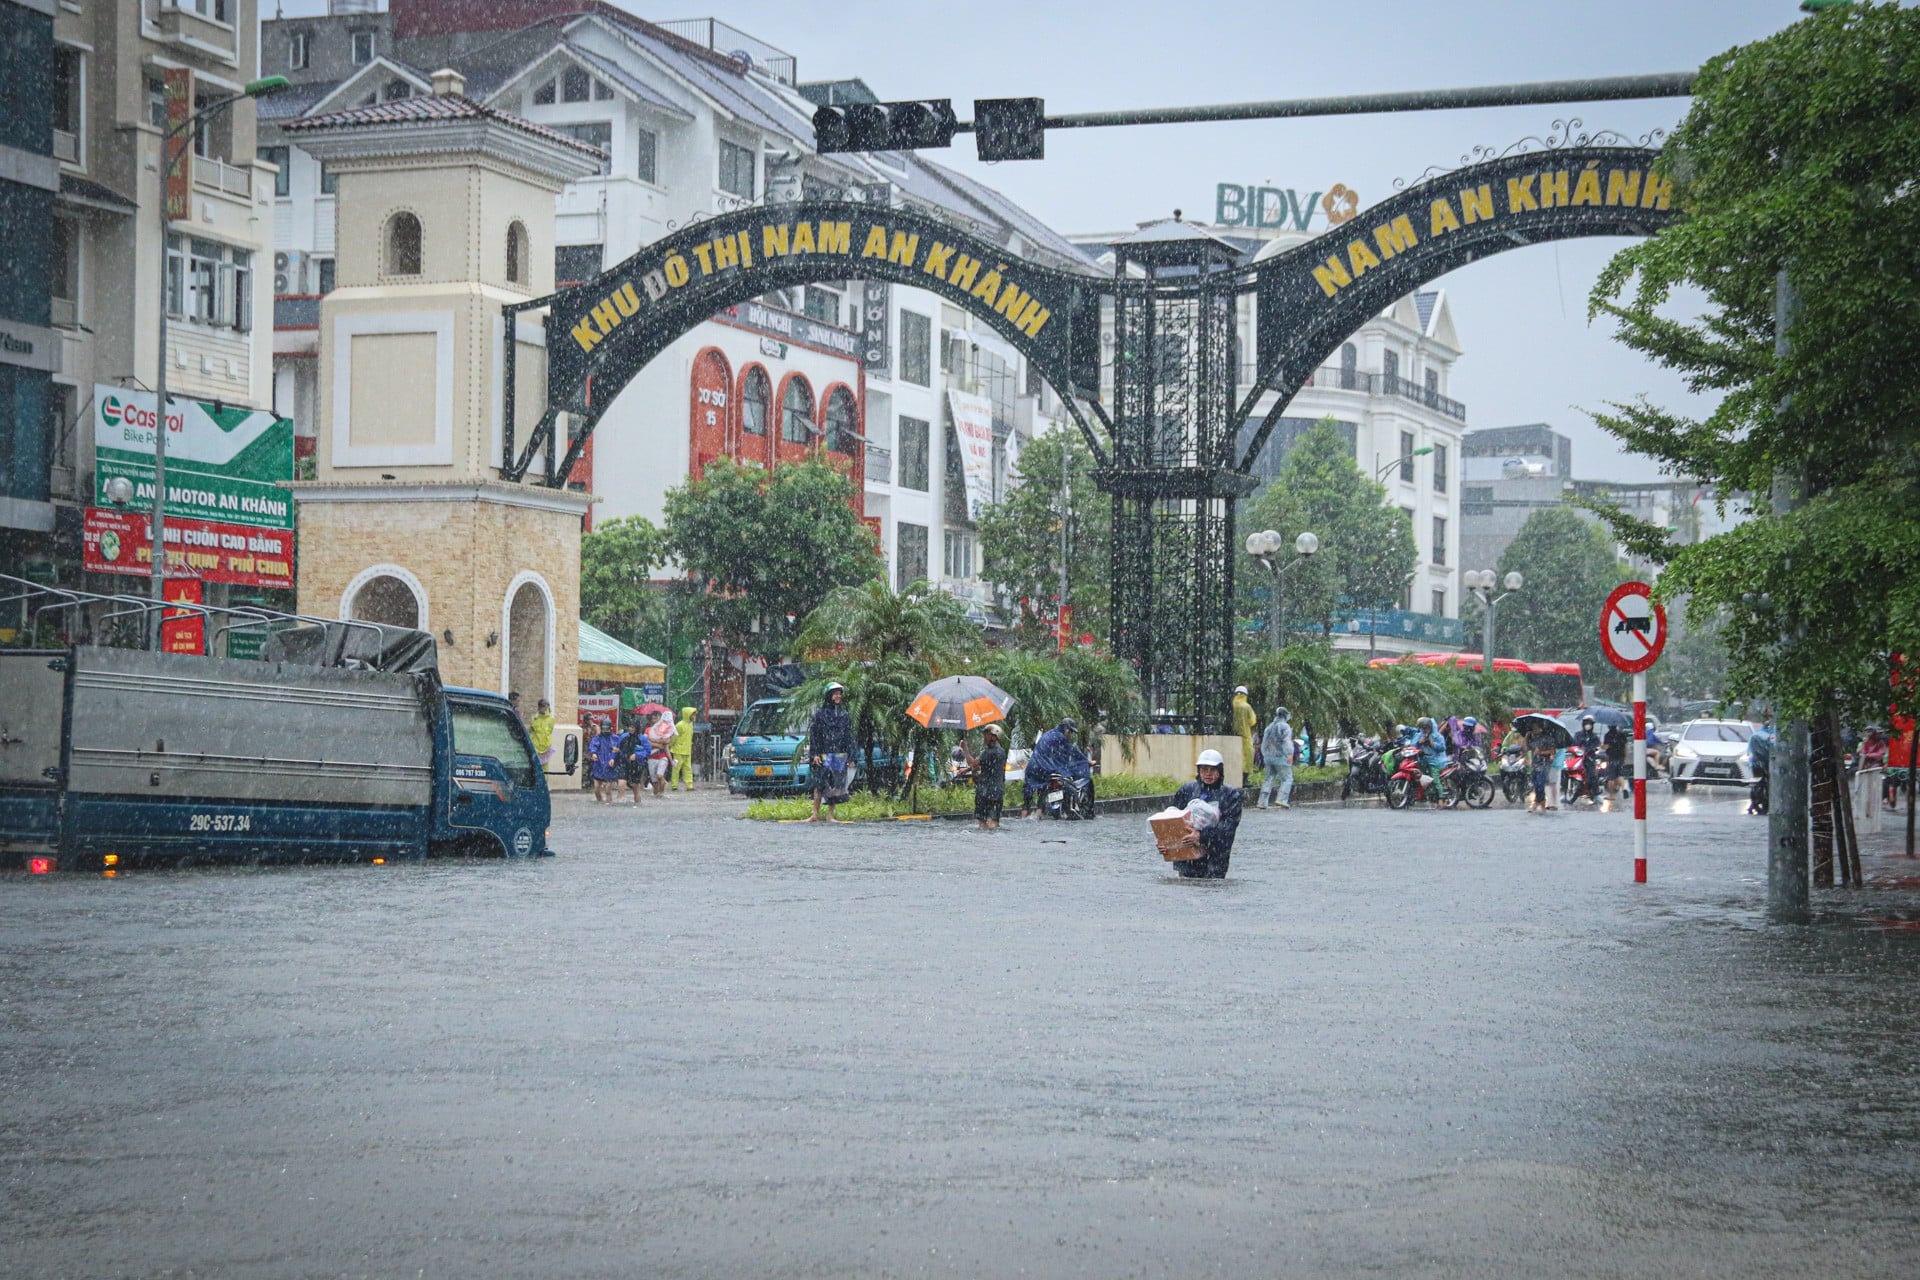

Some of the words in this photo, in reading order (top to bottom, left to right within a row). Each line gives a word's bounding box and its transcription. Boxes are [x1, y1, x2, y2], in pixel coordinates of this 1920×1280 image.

[1215, 182, 1322, 231] BIDV
[1312, 213, 1418, 298] NAM
[1429, 184, 1496, 238] AN
[1507, 161, 1673, 215] KHÁNH
[571, 281, 642, 353] KHU
[643, 248, 690, 302] ĐÔ
[692, 229, 753, 268] THỊ
[763, 220, 851, 257] NAM
[862, 225, 921, 267] AN
[923, 241, 1052, 340] KHÁNH
[748, 304, 768, 329] HỘI
[769, 311, 793, 338] NGHỊ
[807, 325, 830, 347] SINH
[124, 404, 184, 433] Casrol
[124, 428, 144, 443] Bike
[137, 483, 166, 500] AN
[169, 486, 216, 507] MOTOR
[219, 495, 239, 510] AN
[242, 493, 287, 518] KHÁNH
[221, 534, 246, 551] CAO
[248, 533, 283, 554] BẰNG
[188, 552, 220, 569] QUAY
[228, 553, 255, 574] PHỞ
[256, 560, 290, 577] CHUA
[190, 814, 251, 831] 29C-537.34
